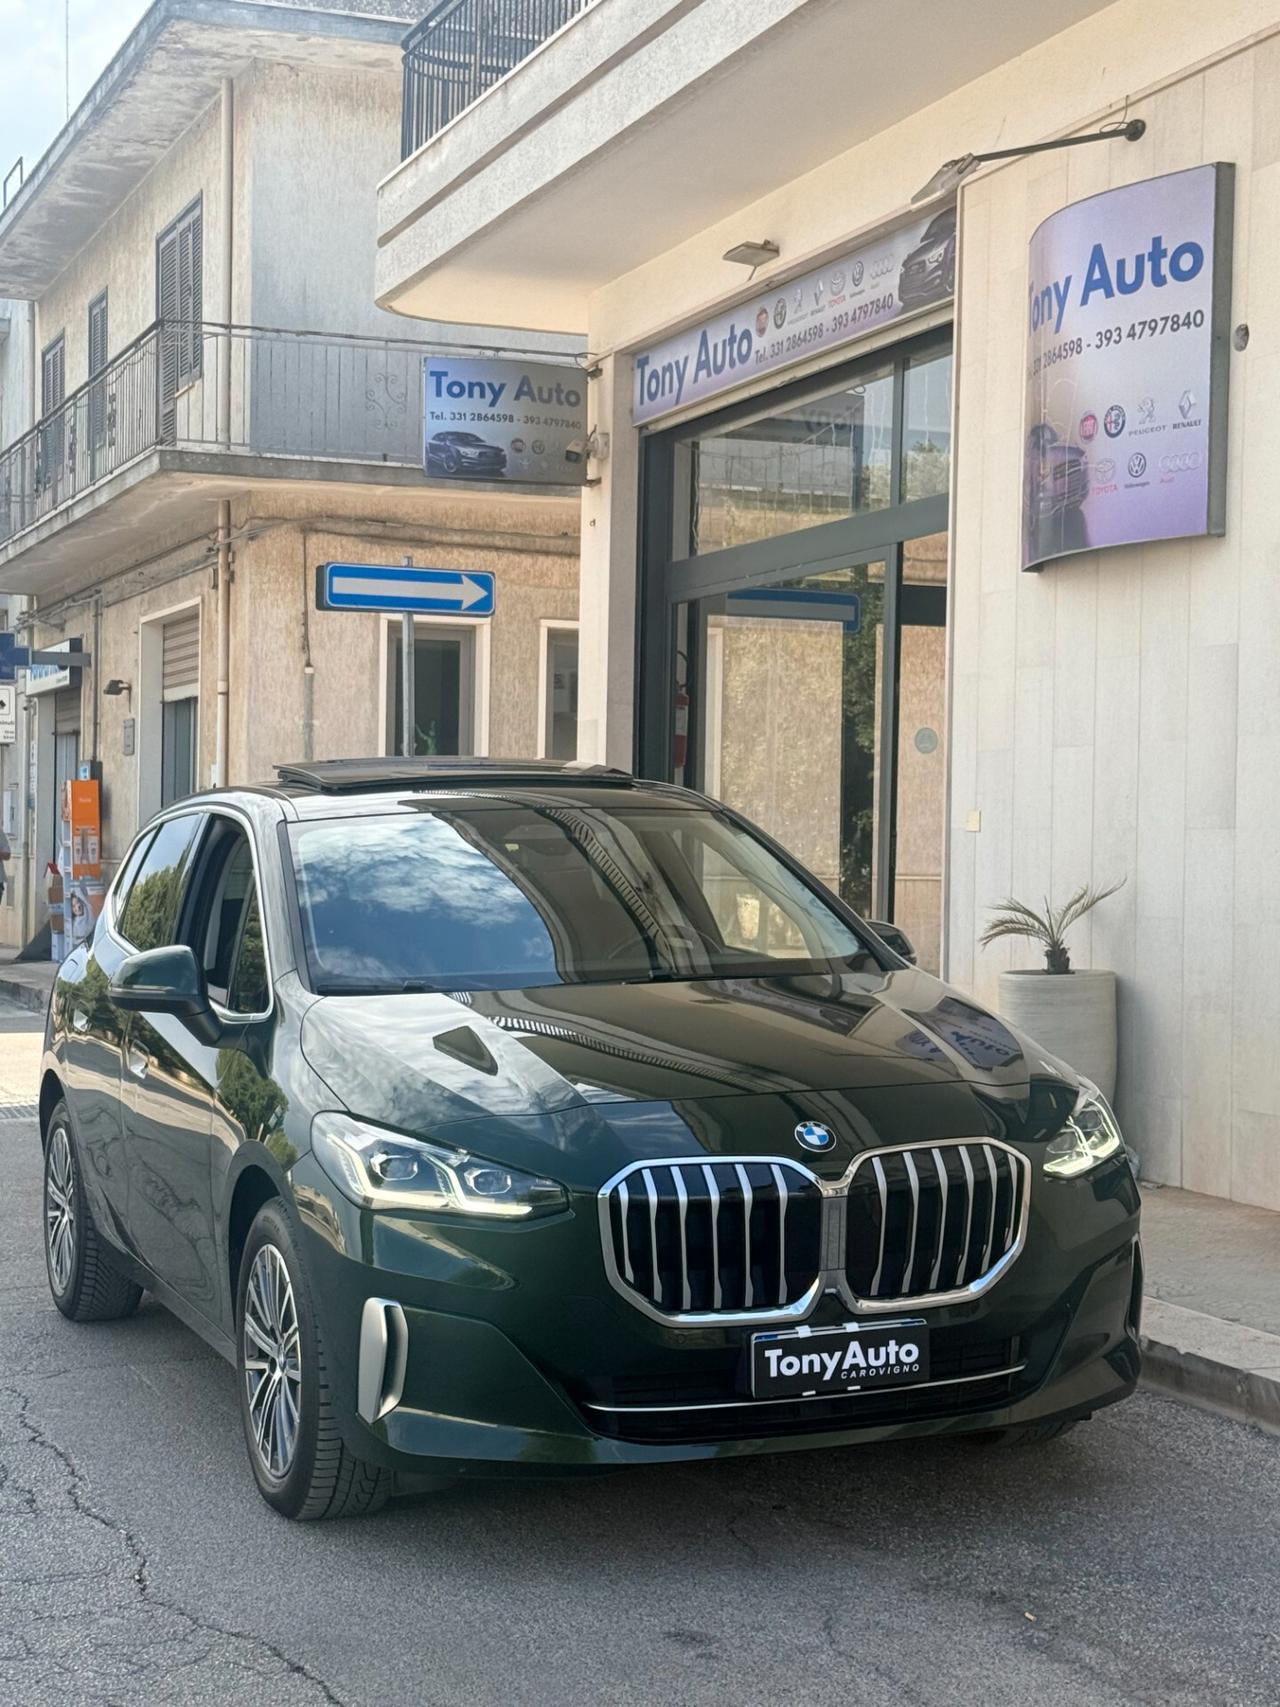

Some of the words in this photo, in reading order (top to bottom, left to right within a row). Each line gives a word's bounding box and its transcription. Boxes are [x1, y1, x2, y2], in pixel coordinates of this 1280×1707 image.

[1080, 235, 1204, 307] Auto
[755, 347, 768, 364] Tel.
[770, 340, 784, 358] 331
[786, 323, 824, 352] 2864598
[832, 312, 849, 333] 393
[850, 292, 894, 324] 4797840
[1095, 326, 1122, 349] 393
[1126, 309, 1204, 341] 4797840
[637, 355, 689, 406] Tony
[693, 323, 753, 384] Auto
[429, 371, 506, 407] Tony
[514, 375, 581, 408] Auto
[430, 411, 447, 421] Tel.
[450, 412, 467, 421] 331
[470, 412, 514, 423] 2864598
[523, 415, 541, 425] 393
[1128, 425, 1167, 437] PEUGEOT
[1172, 419, 1201, 430] RENAULT
[840, 1363, 920, 1380] CAROVIGNO
